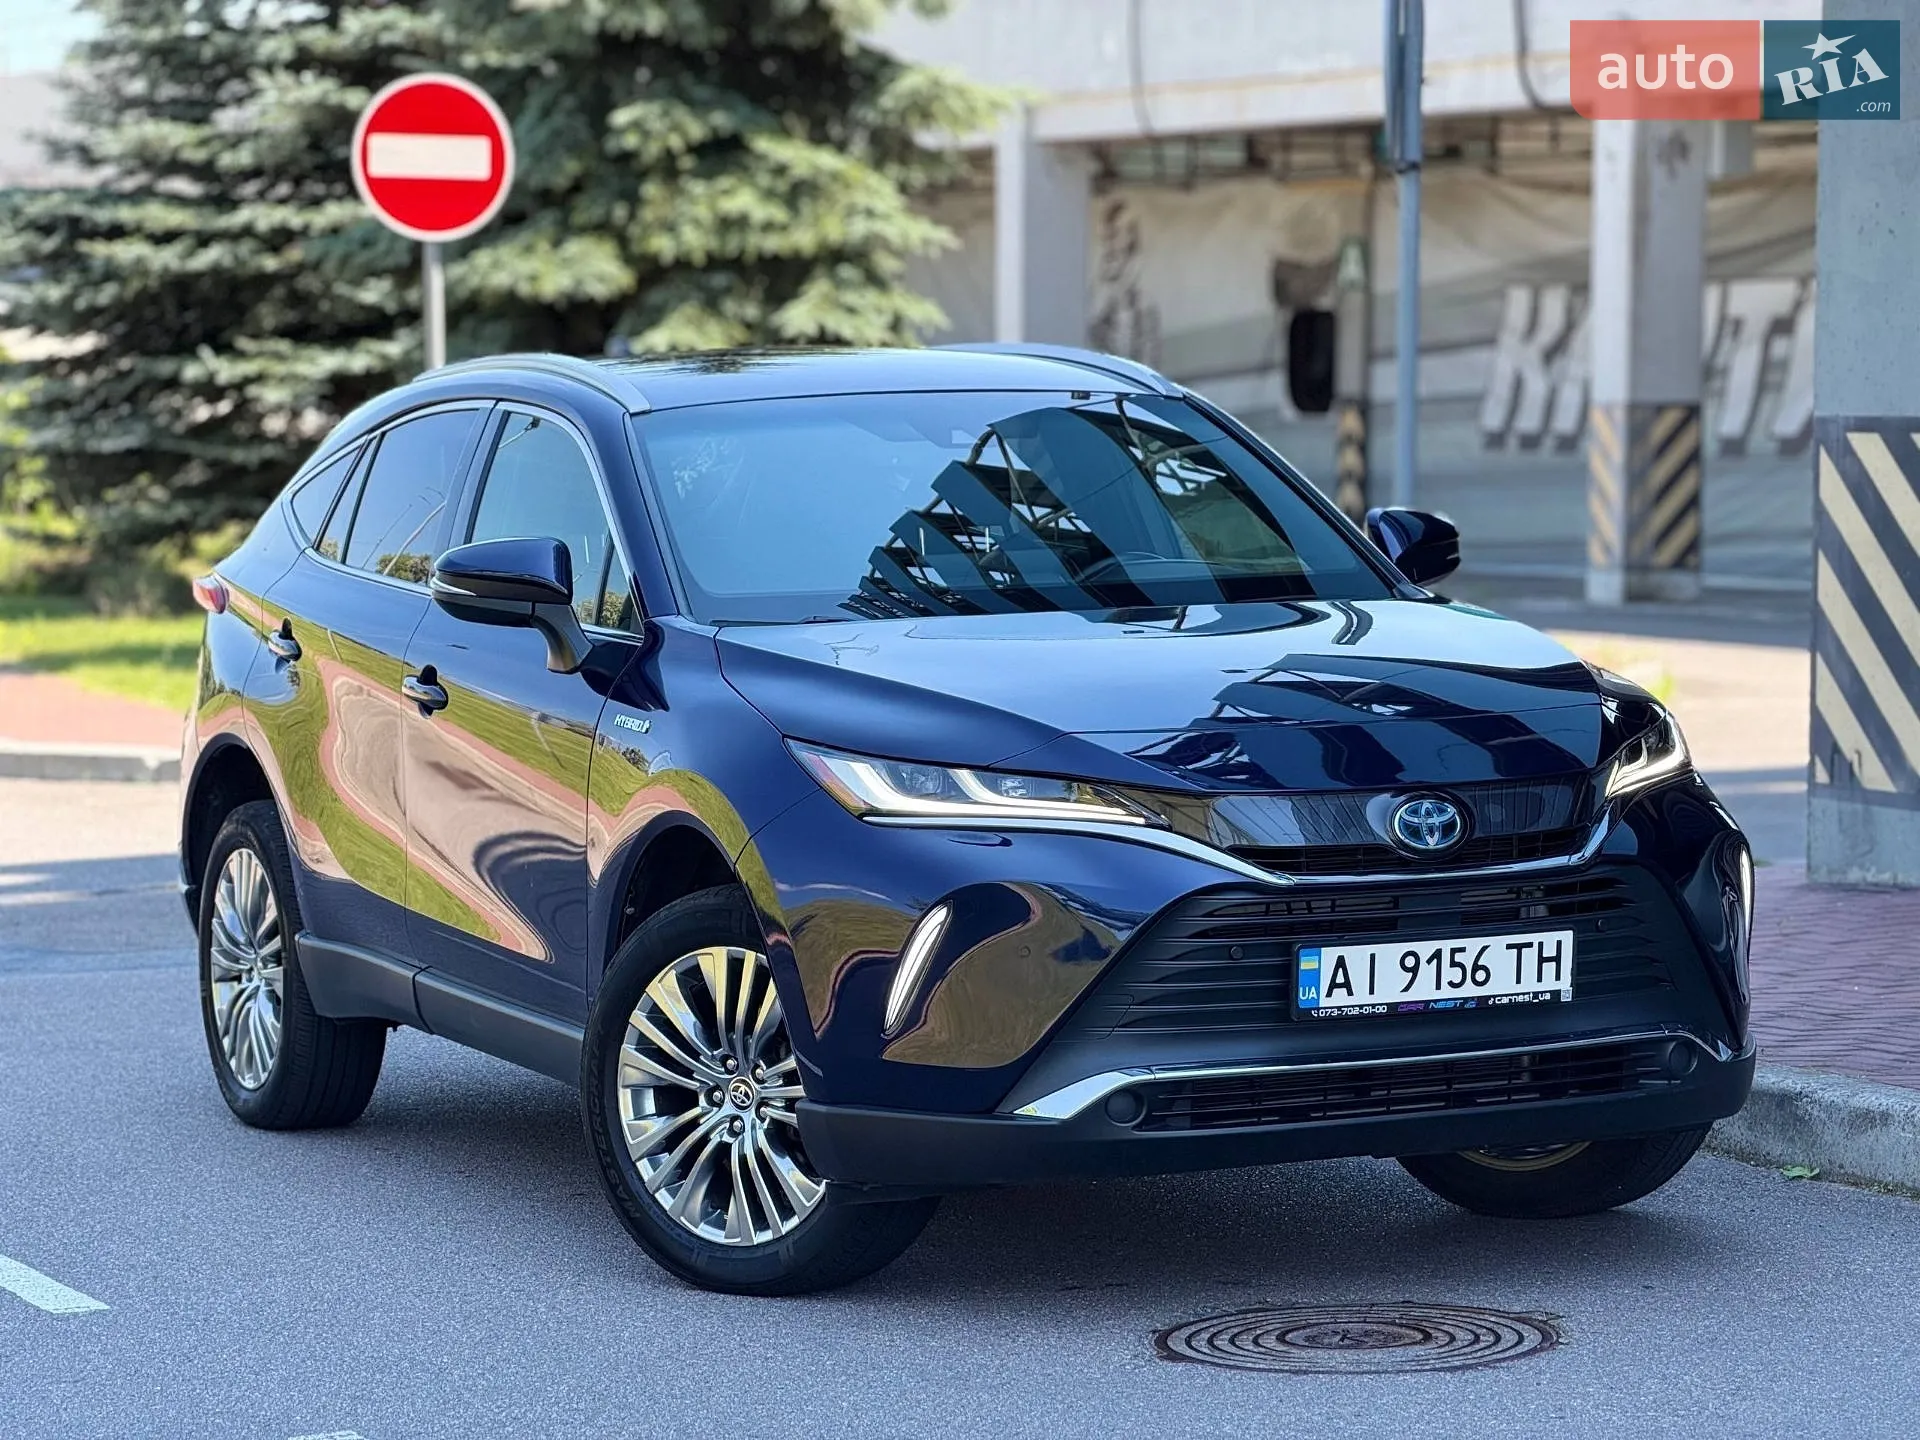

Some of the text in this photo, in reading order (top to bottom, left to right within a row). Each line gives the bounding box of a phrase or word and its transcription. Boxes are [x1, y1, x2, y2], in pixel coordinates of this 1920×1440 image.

[614, 714, 643, 732] HYBRID
[1325, 939, 1563, 998] AI 9156 TH
[1299, 987, 1318, 1001] UA
[1495, 992, 1551, 1004] carnest_ua
[1429, 999, 1464, 1009] NEST
[1319, 1005, 1388, 1017] 073-702-01-00
